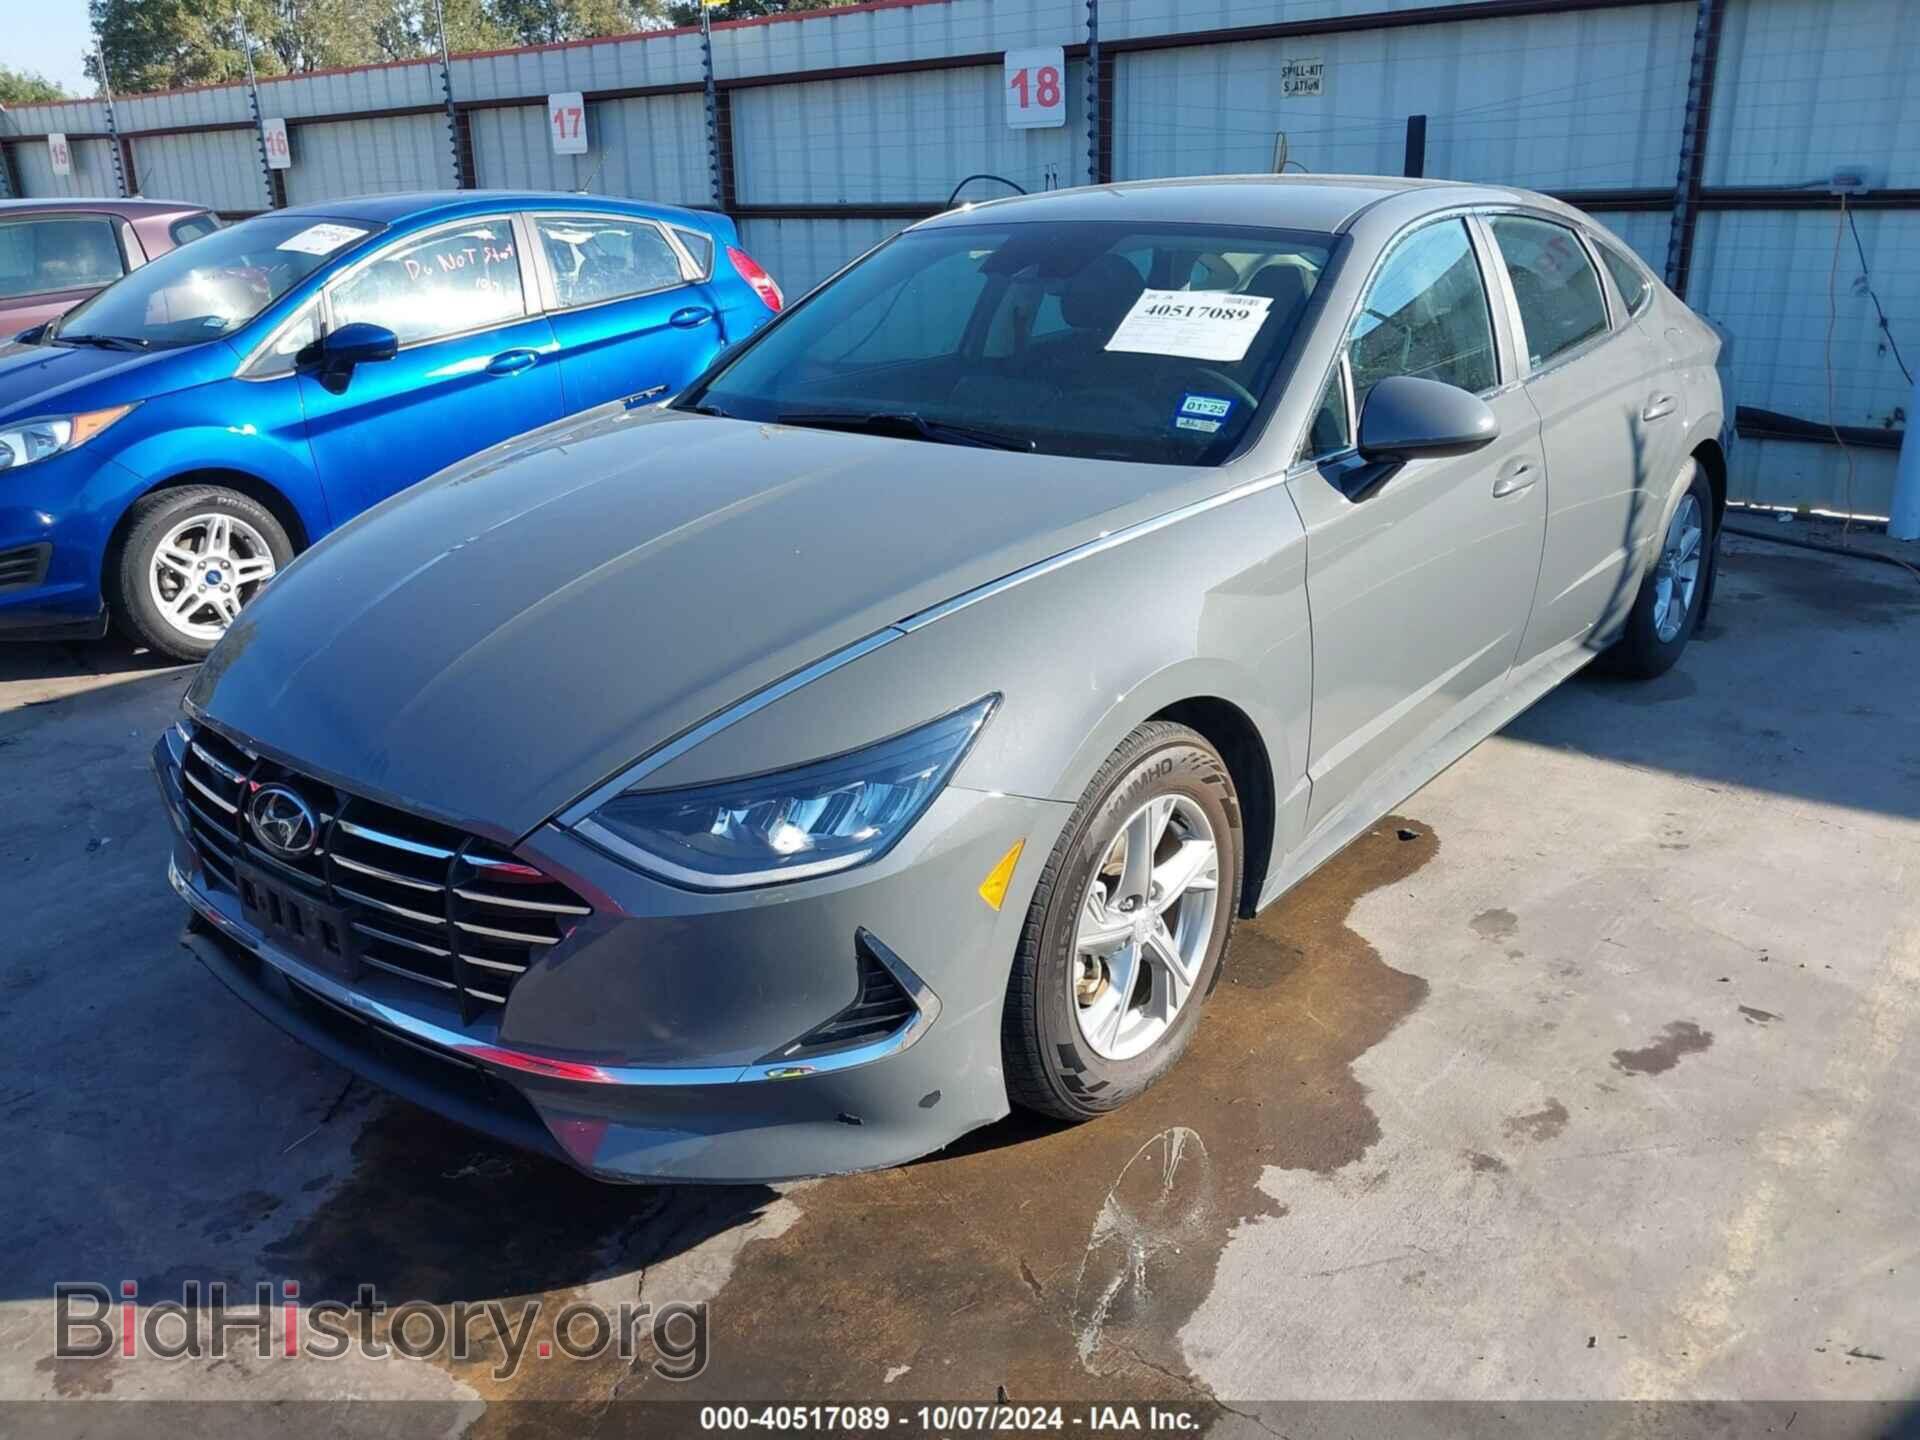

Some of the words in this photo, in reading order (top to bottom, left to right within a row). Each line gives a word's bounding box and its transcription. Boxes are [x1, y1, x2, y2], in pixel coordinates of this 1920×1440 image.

[1010, 66, 1061, 109] 18
[1284, 79, 1320, 92] SATION
[554, 107, 582, 139] 17
[52, 144, 66, 165] 15
[266, 129, 287, 156] 16
[1145, 302, 1250, 321] 40517089
